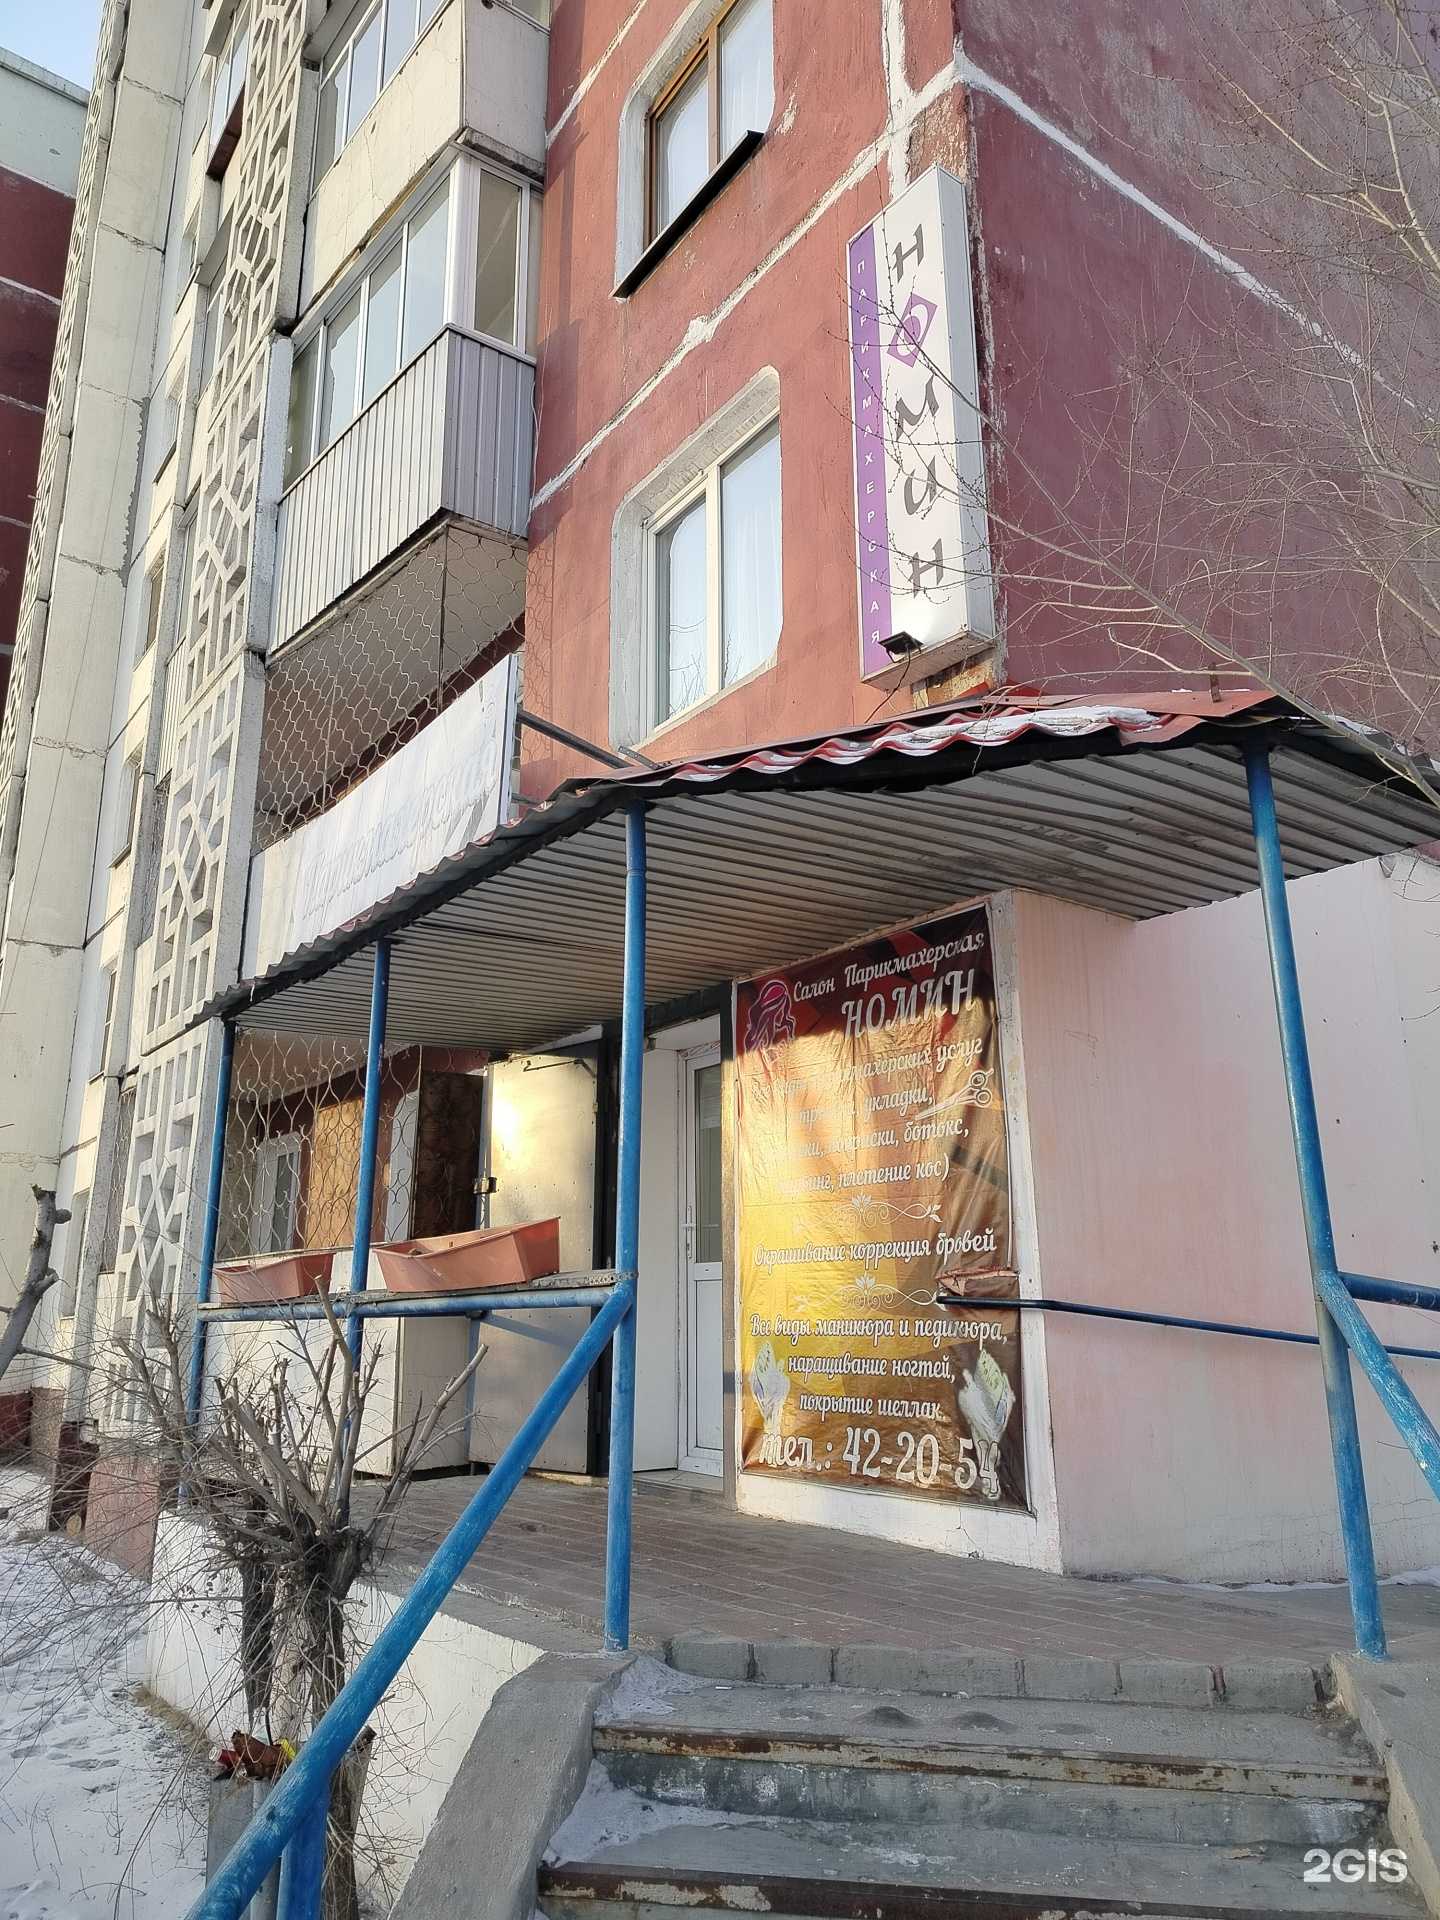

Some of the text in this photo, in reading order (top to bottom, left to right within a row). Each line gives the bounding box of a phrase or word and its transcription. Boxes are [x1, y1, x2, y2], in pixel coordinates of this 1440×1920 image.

[889, 224, 944, 598] НОМИН
[857, 260, 881, 643] ПАРИКМАХЕРСКАЯ
[793, 932, 985, 1002] Салон Парикмахерская
[841, 968, 977, 1040] НОМИН
[936, 1037, 983, 1072] услуг
[904, 1117, 969, 1144] ботокс,
[838, 1164, 911, 1189] плетение
[916, 1153, 949, 1182] кос)
[753, 1227, 998, 1274] Окрашивание коррекция бровей
[750, 1314, 1008, 1351] Все виды маникюра и педикюра,
[788, 1352, 956, 1384] наращивание ногтей,
[799, 1394, 946, 1421] покрытие шеллак.
[843, 1426, 1000, 1494] 42-20-54
